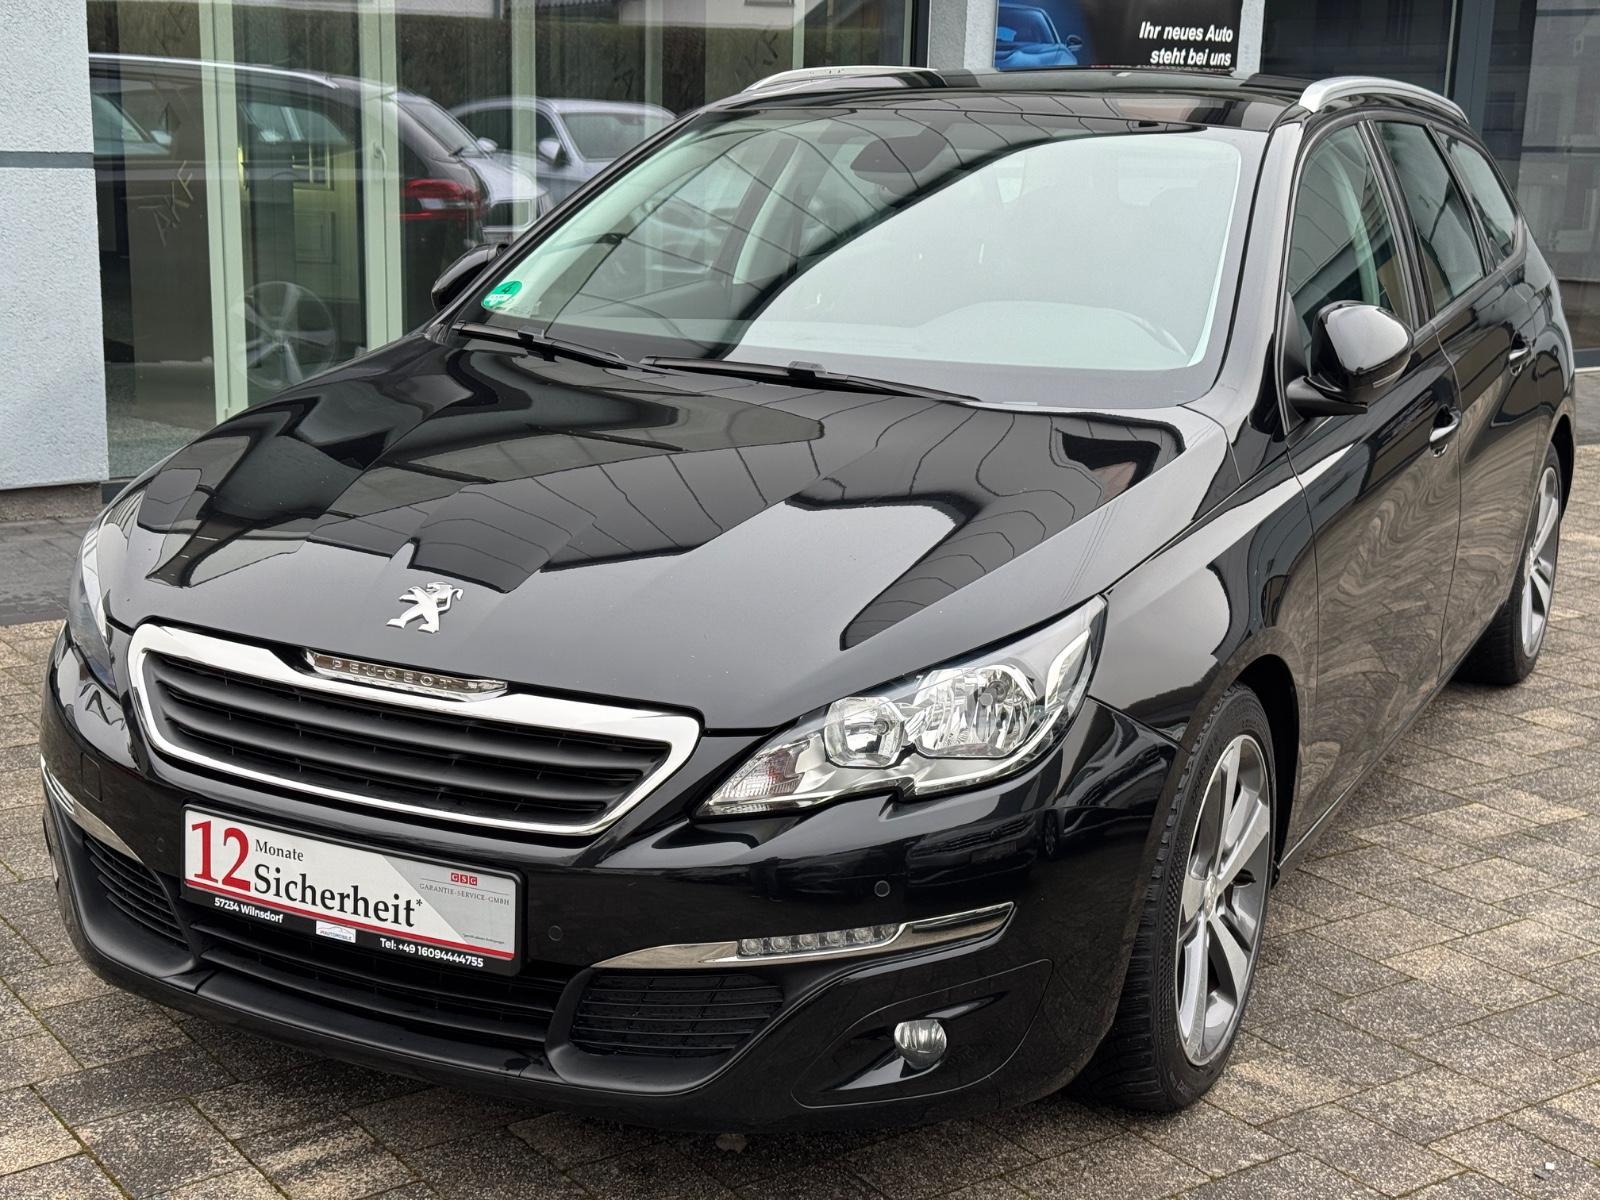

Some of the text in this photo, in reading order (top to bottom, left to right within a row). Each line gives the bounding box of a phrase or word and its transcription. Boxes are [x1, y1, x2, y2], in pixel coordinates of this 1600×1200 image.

[1139, 21, 1234, 42] Ihr neues Auto
[1150, 47, 1232, 66] steht bei uns
[331, 659, 453, 690] PEUGEOT
[191, 820, 251, 892] 12
[255, 839, 304, 861] Monate
[450, 872, 478, 886] GSG
[214, 897, 284, 923] 57234 Wilnsdorf
[380, 937, 484, 968] Tel: +49 16094444755
